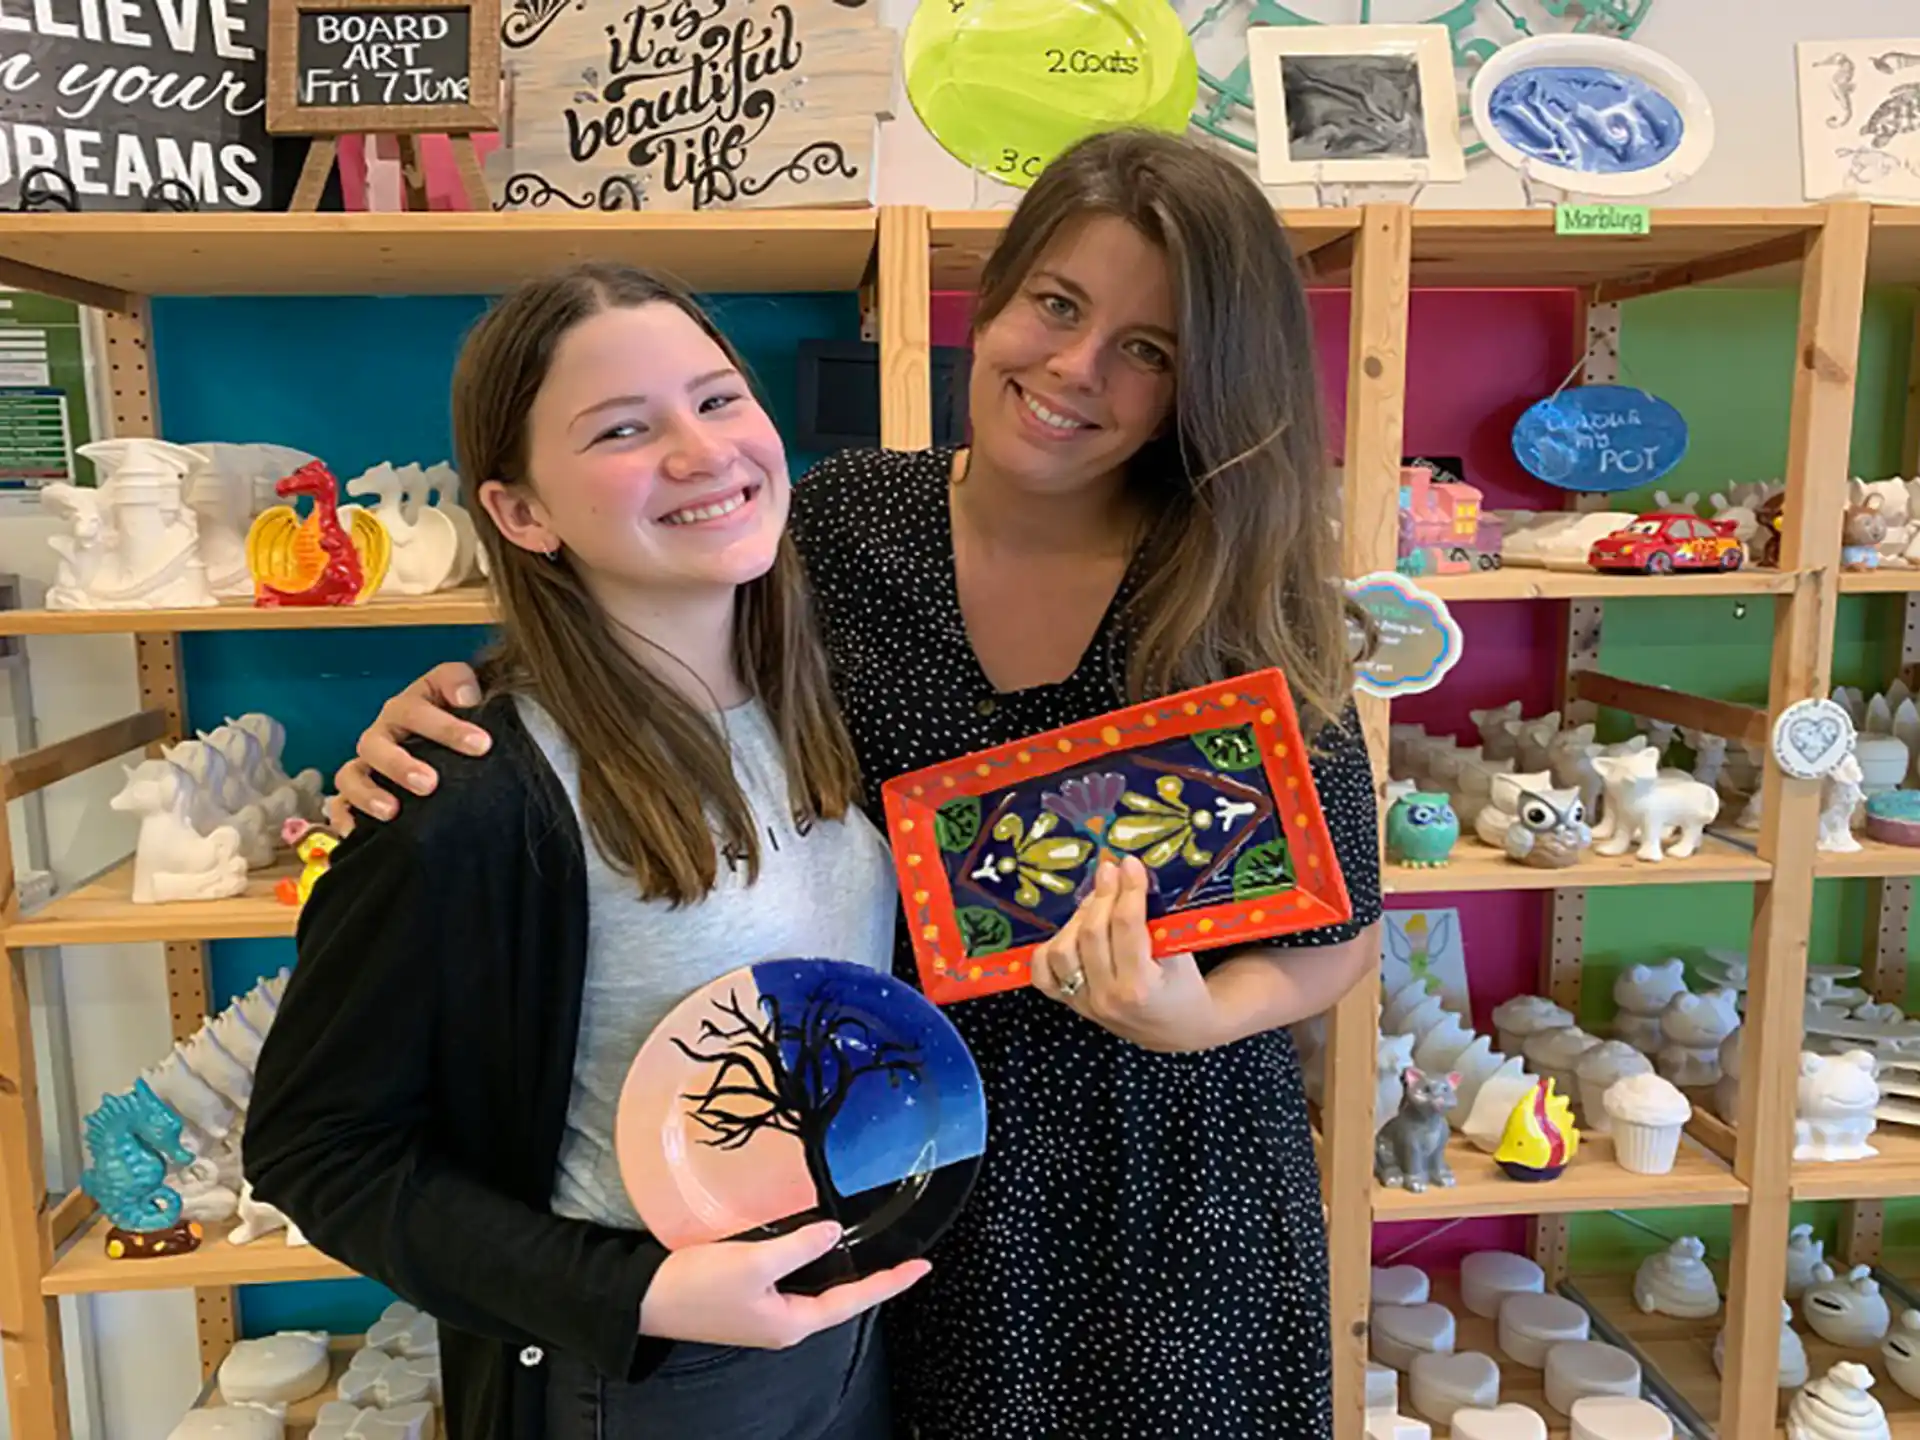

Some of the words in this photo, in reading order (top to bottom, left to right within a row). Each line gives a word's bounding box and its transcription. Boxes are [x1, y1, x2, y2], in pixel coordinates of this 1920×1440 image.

[316, 14, 449, 44] BOARD
[342, 43, 421, 70] ART
[653, 46, 686, 68] a
[55, 62, 265, 119] your
[305, 68, 361, 103] Fri
[374, 71, 400, 103] 7
[403, 67, 470, 103] June
[564, 4, 802, 162] beautiful
[0, 123, 262, 208] REAMS
[652, 124, 748, 206] life
[1563, 206, 1643, 235] Marbling
[1599, 445, 1661, 474] POT
